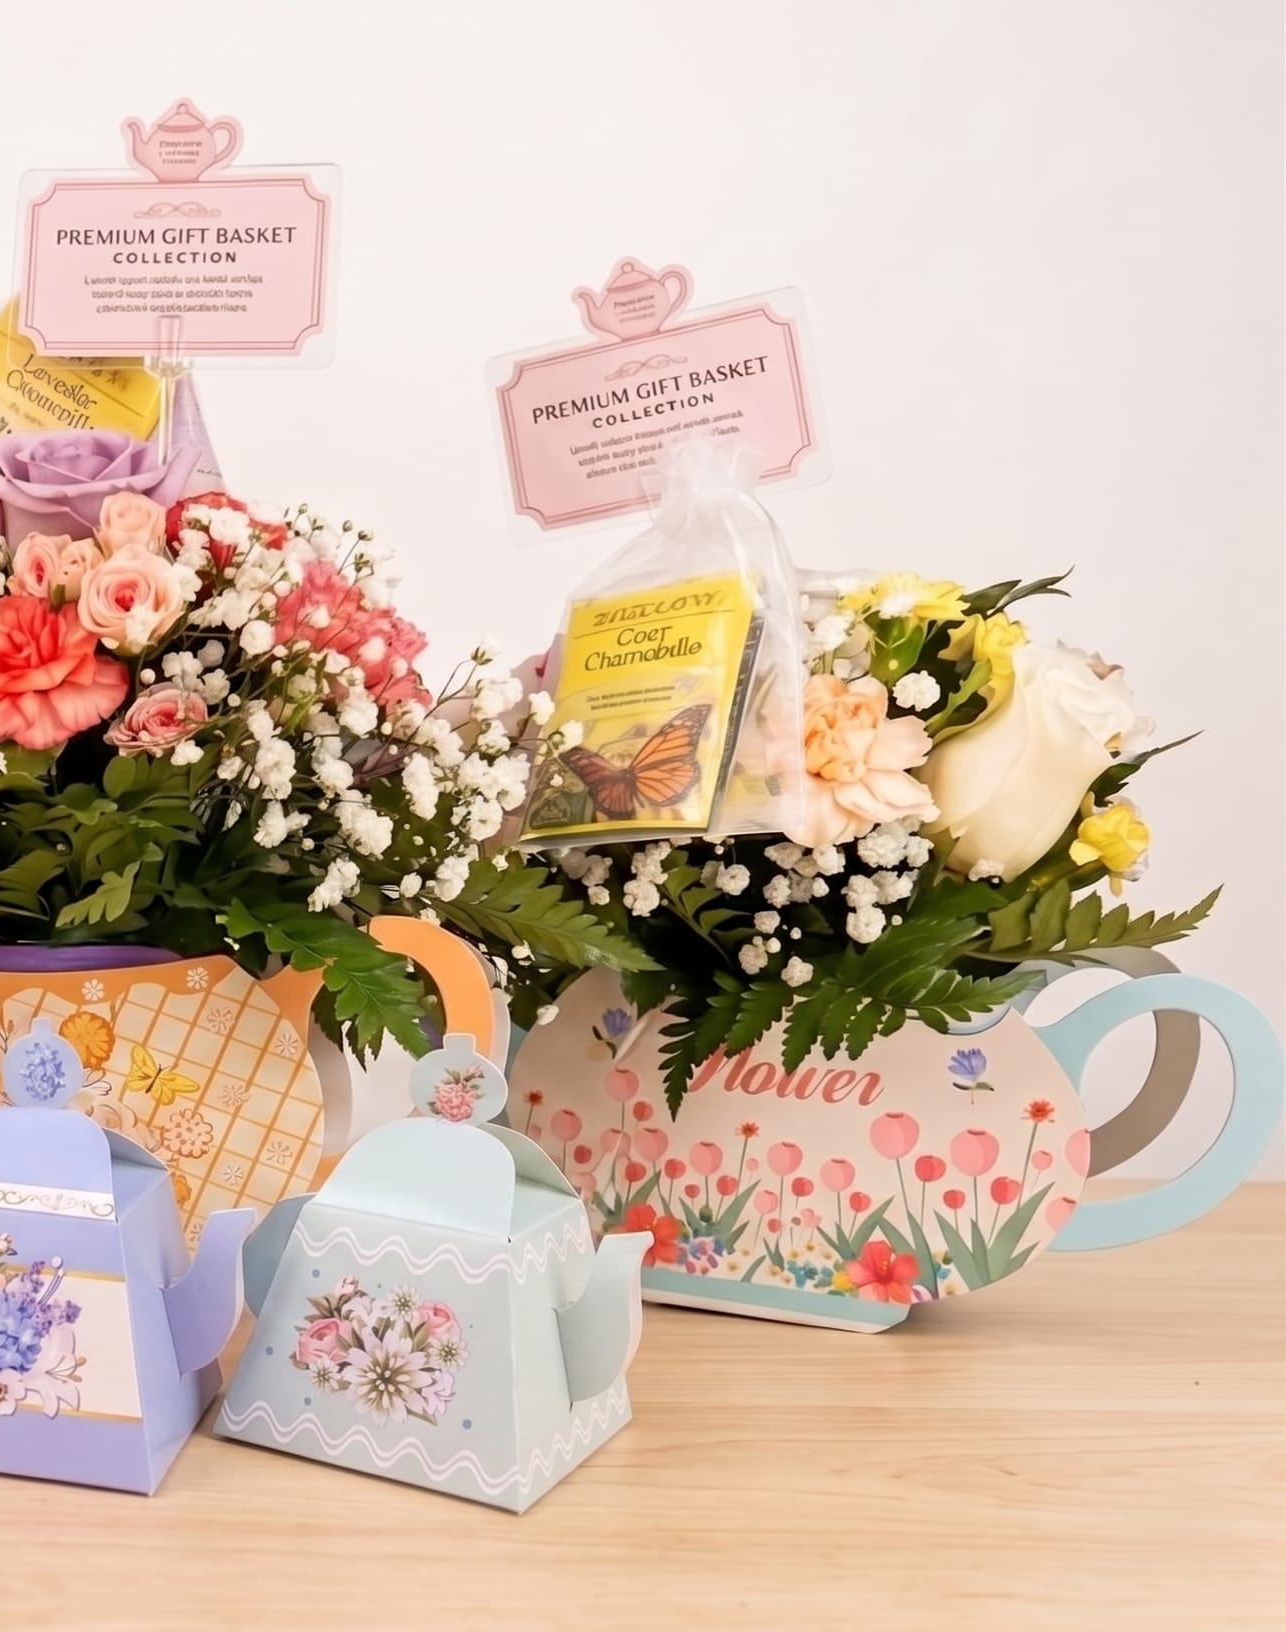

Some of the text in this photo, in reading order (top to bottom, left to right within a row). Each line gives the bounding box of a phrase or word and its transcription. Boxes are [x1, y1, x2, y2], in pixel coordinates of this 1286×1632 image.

[56, 227, 297, 245] PREMIUM GIFT BASKET
[113, 252, 237, 264] COLLECTION
[532, 356, 768, 424] PREMIUM GIFT BASKET
[593, 393, 715, 428] COLLECTION
